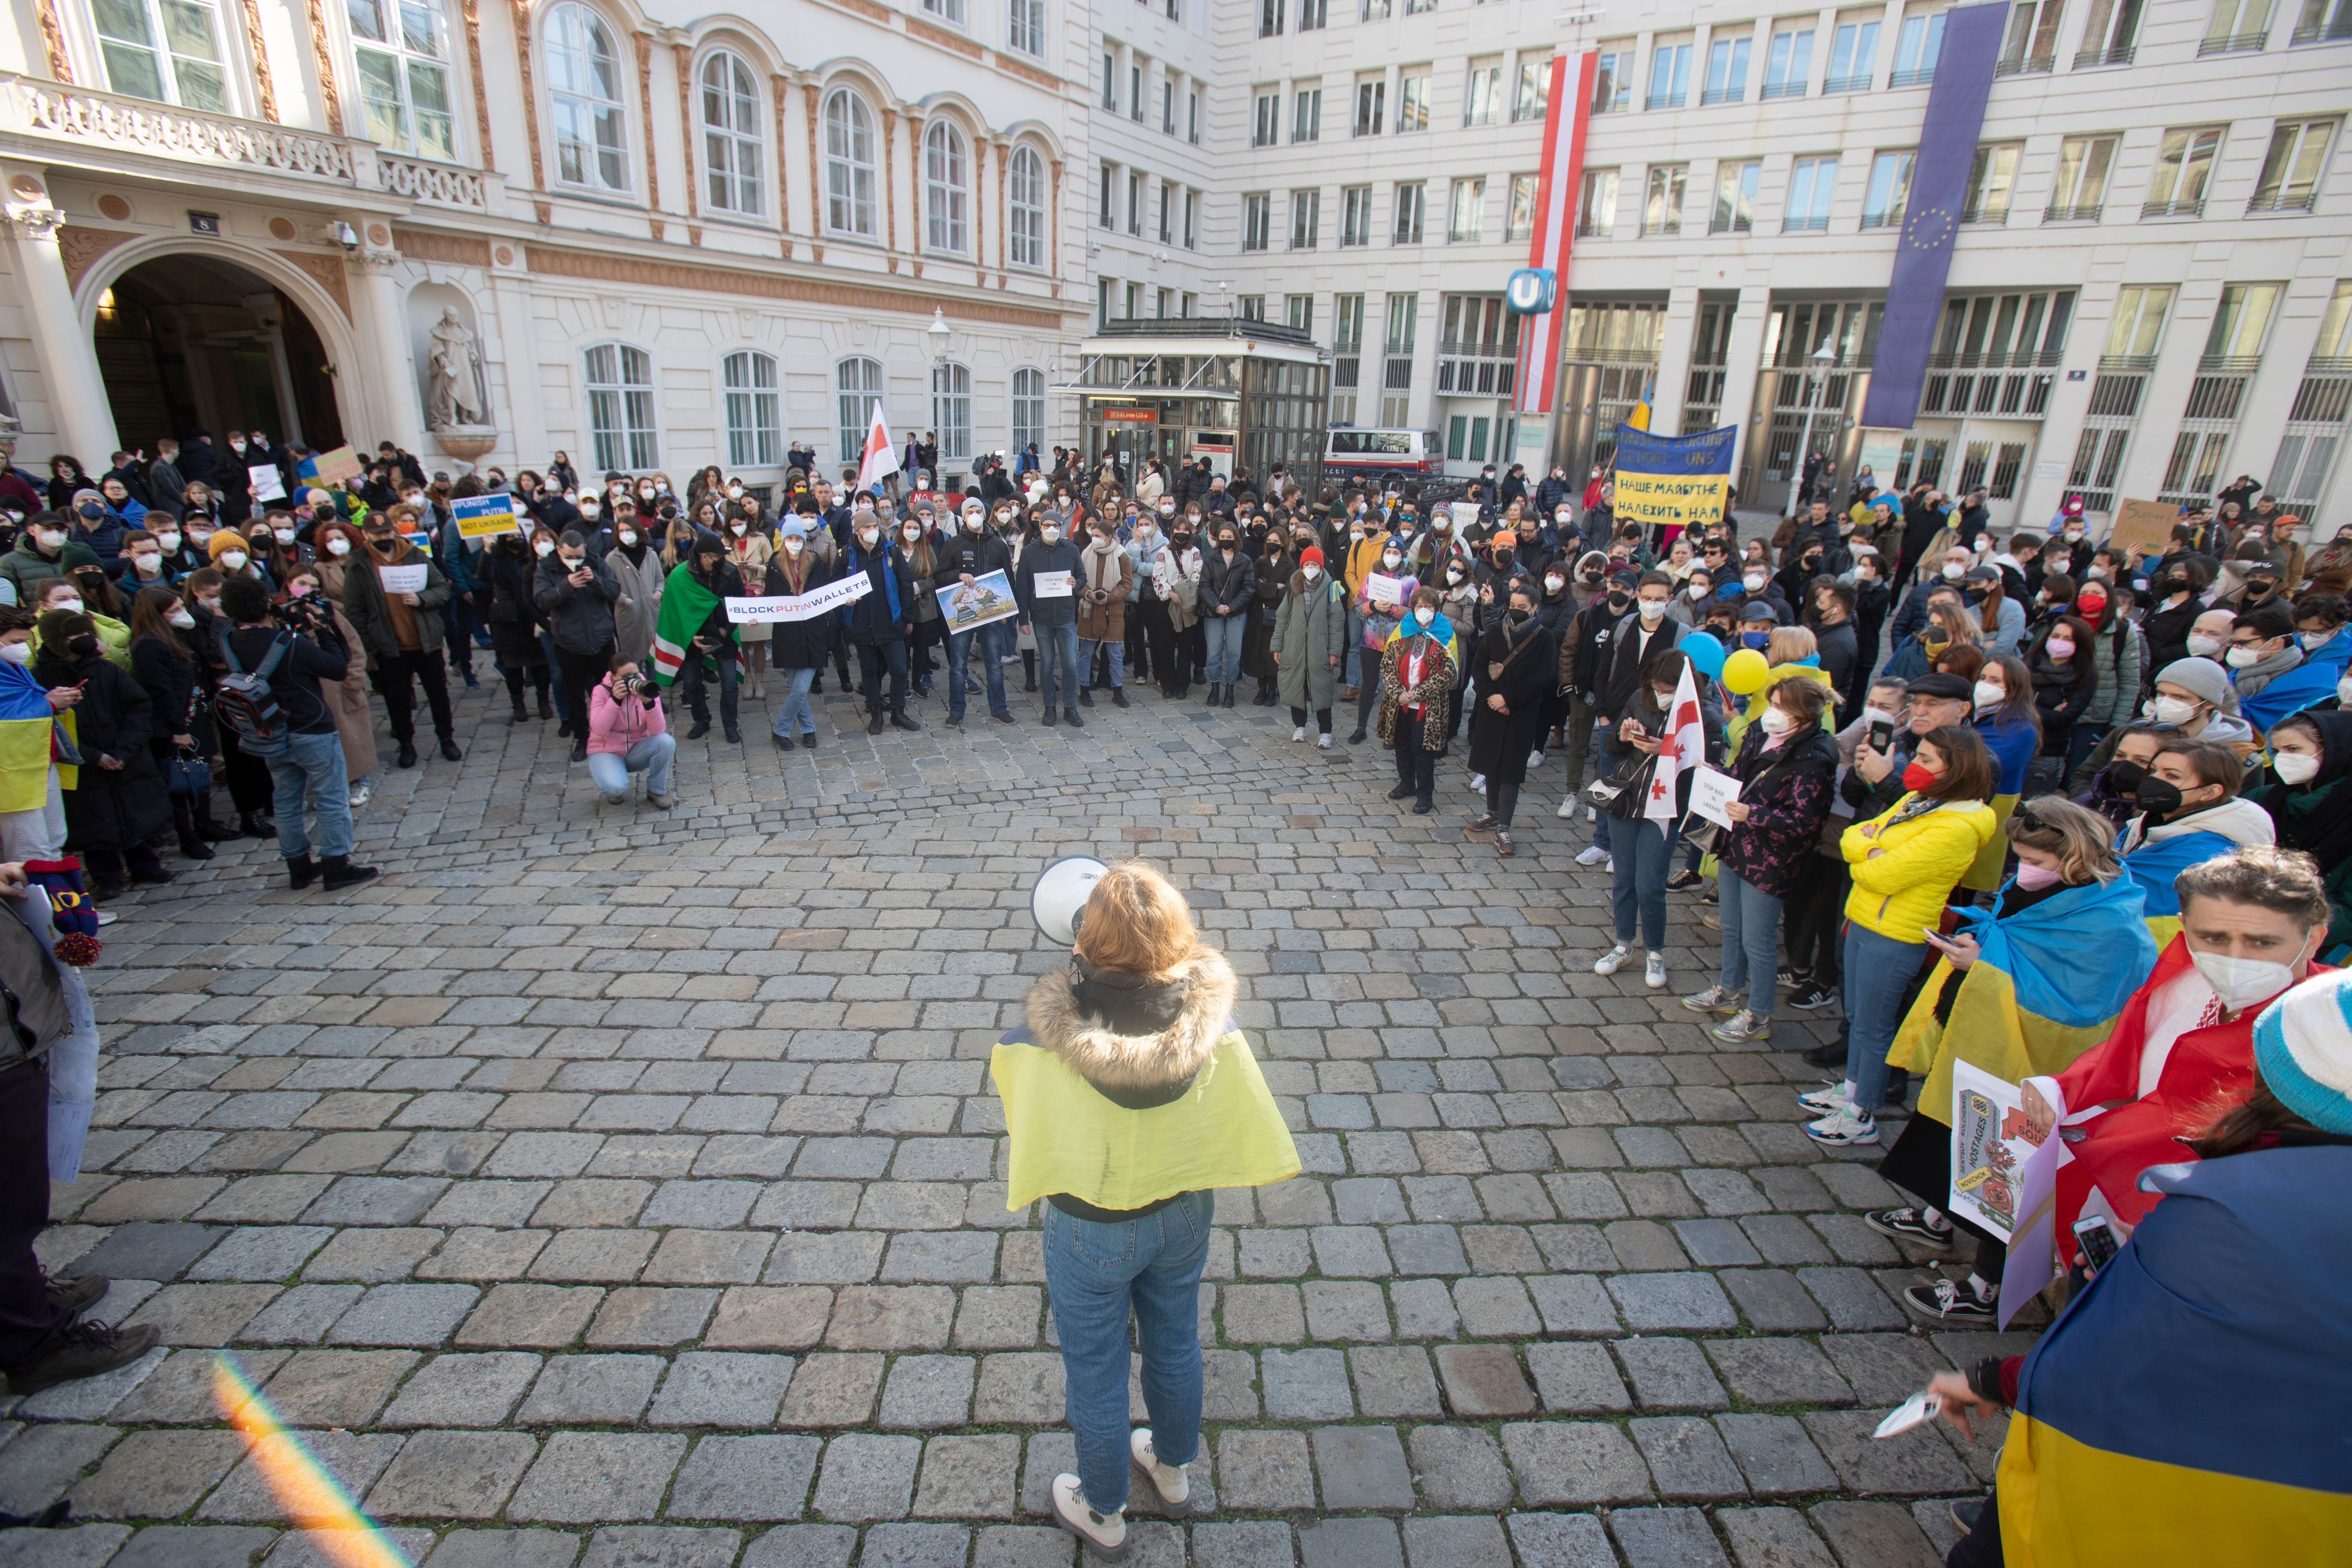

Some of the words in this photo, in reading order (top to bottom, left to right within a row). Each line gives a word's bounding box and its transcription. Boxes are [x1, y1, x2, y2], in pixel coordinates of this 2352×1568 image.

[200, 220, 210, 230] 8
[1513, 278, 1540, 308] U
[1547, 279, 1557, 309] U
[1686, 451, 1715, 466] UNS
[1620, 479, 1652, 493] НАШЕ
[1654, 483, 1718, 495] МАЙБУТНЄ
[452, 498, 490, 508] #PUNISH
[1618, 501, 1682, 518] НАЛЕЖИТЬ
[1689, 506, 1720, 519] НАМ
[481, 506, 508, 516] PUTIN
[2127, 502, 2173, 523] Support
[461, 521, 477, 530] NOT
[479, 517, 513, 528] UKRAINE
[2118, 522, 2166, 543] Ukraine
[1704, 782, 1713, 791] STOP
[1715, 788, 1724, 797] WAR
[1703, 801, 1721, 814] UKRAINE
[1969, 1116, 1986, 1168] HOSTAGES
[1960, 1171, 1987, 1188] NOVICHOK
[1994, 1213, 2010, 1227] BUK
